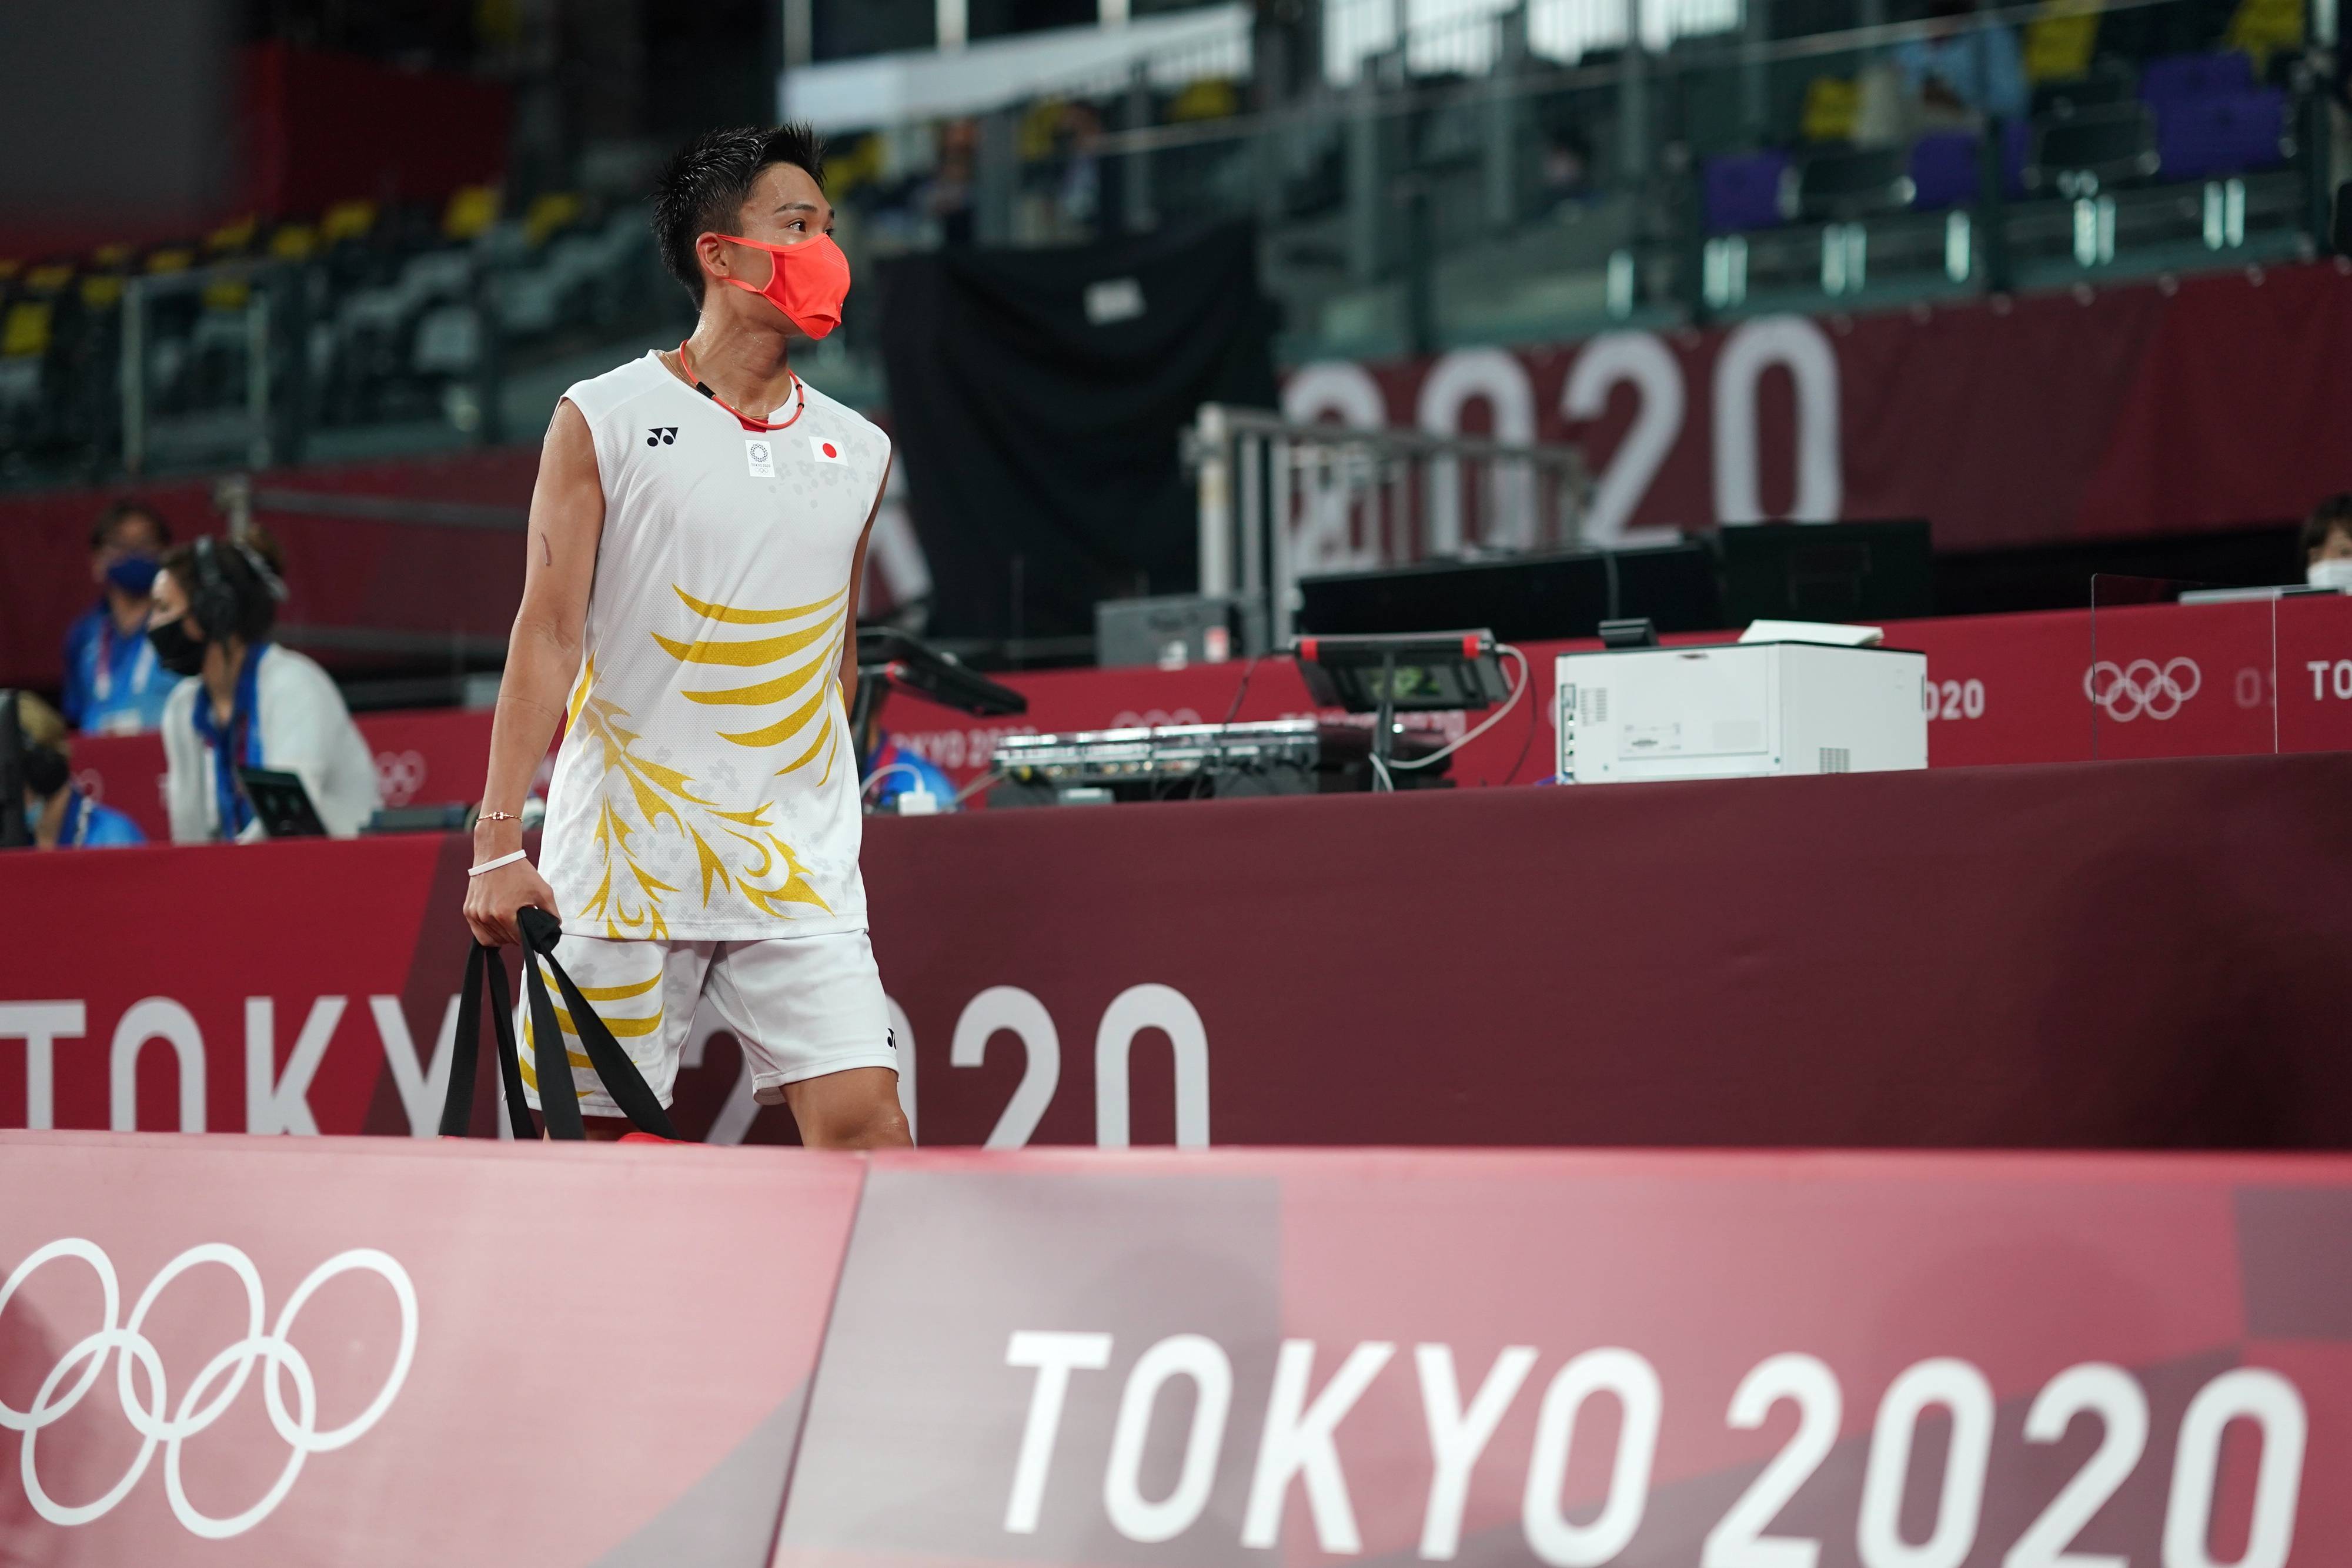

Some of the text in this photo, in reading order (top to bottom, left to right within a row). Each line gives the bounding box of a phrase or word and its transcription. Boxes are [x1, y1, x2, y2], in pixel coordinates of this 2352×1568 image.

[1927, 678, 1985, 721] 020
[0, 995, 517, 1139] TOKY
[1004, 1329, 2310, 1568] TOKYO 2020
